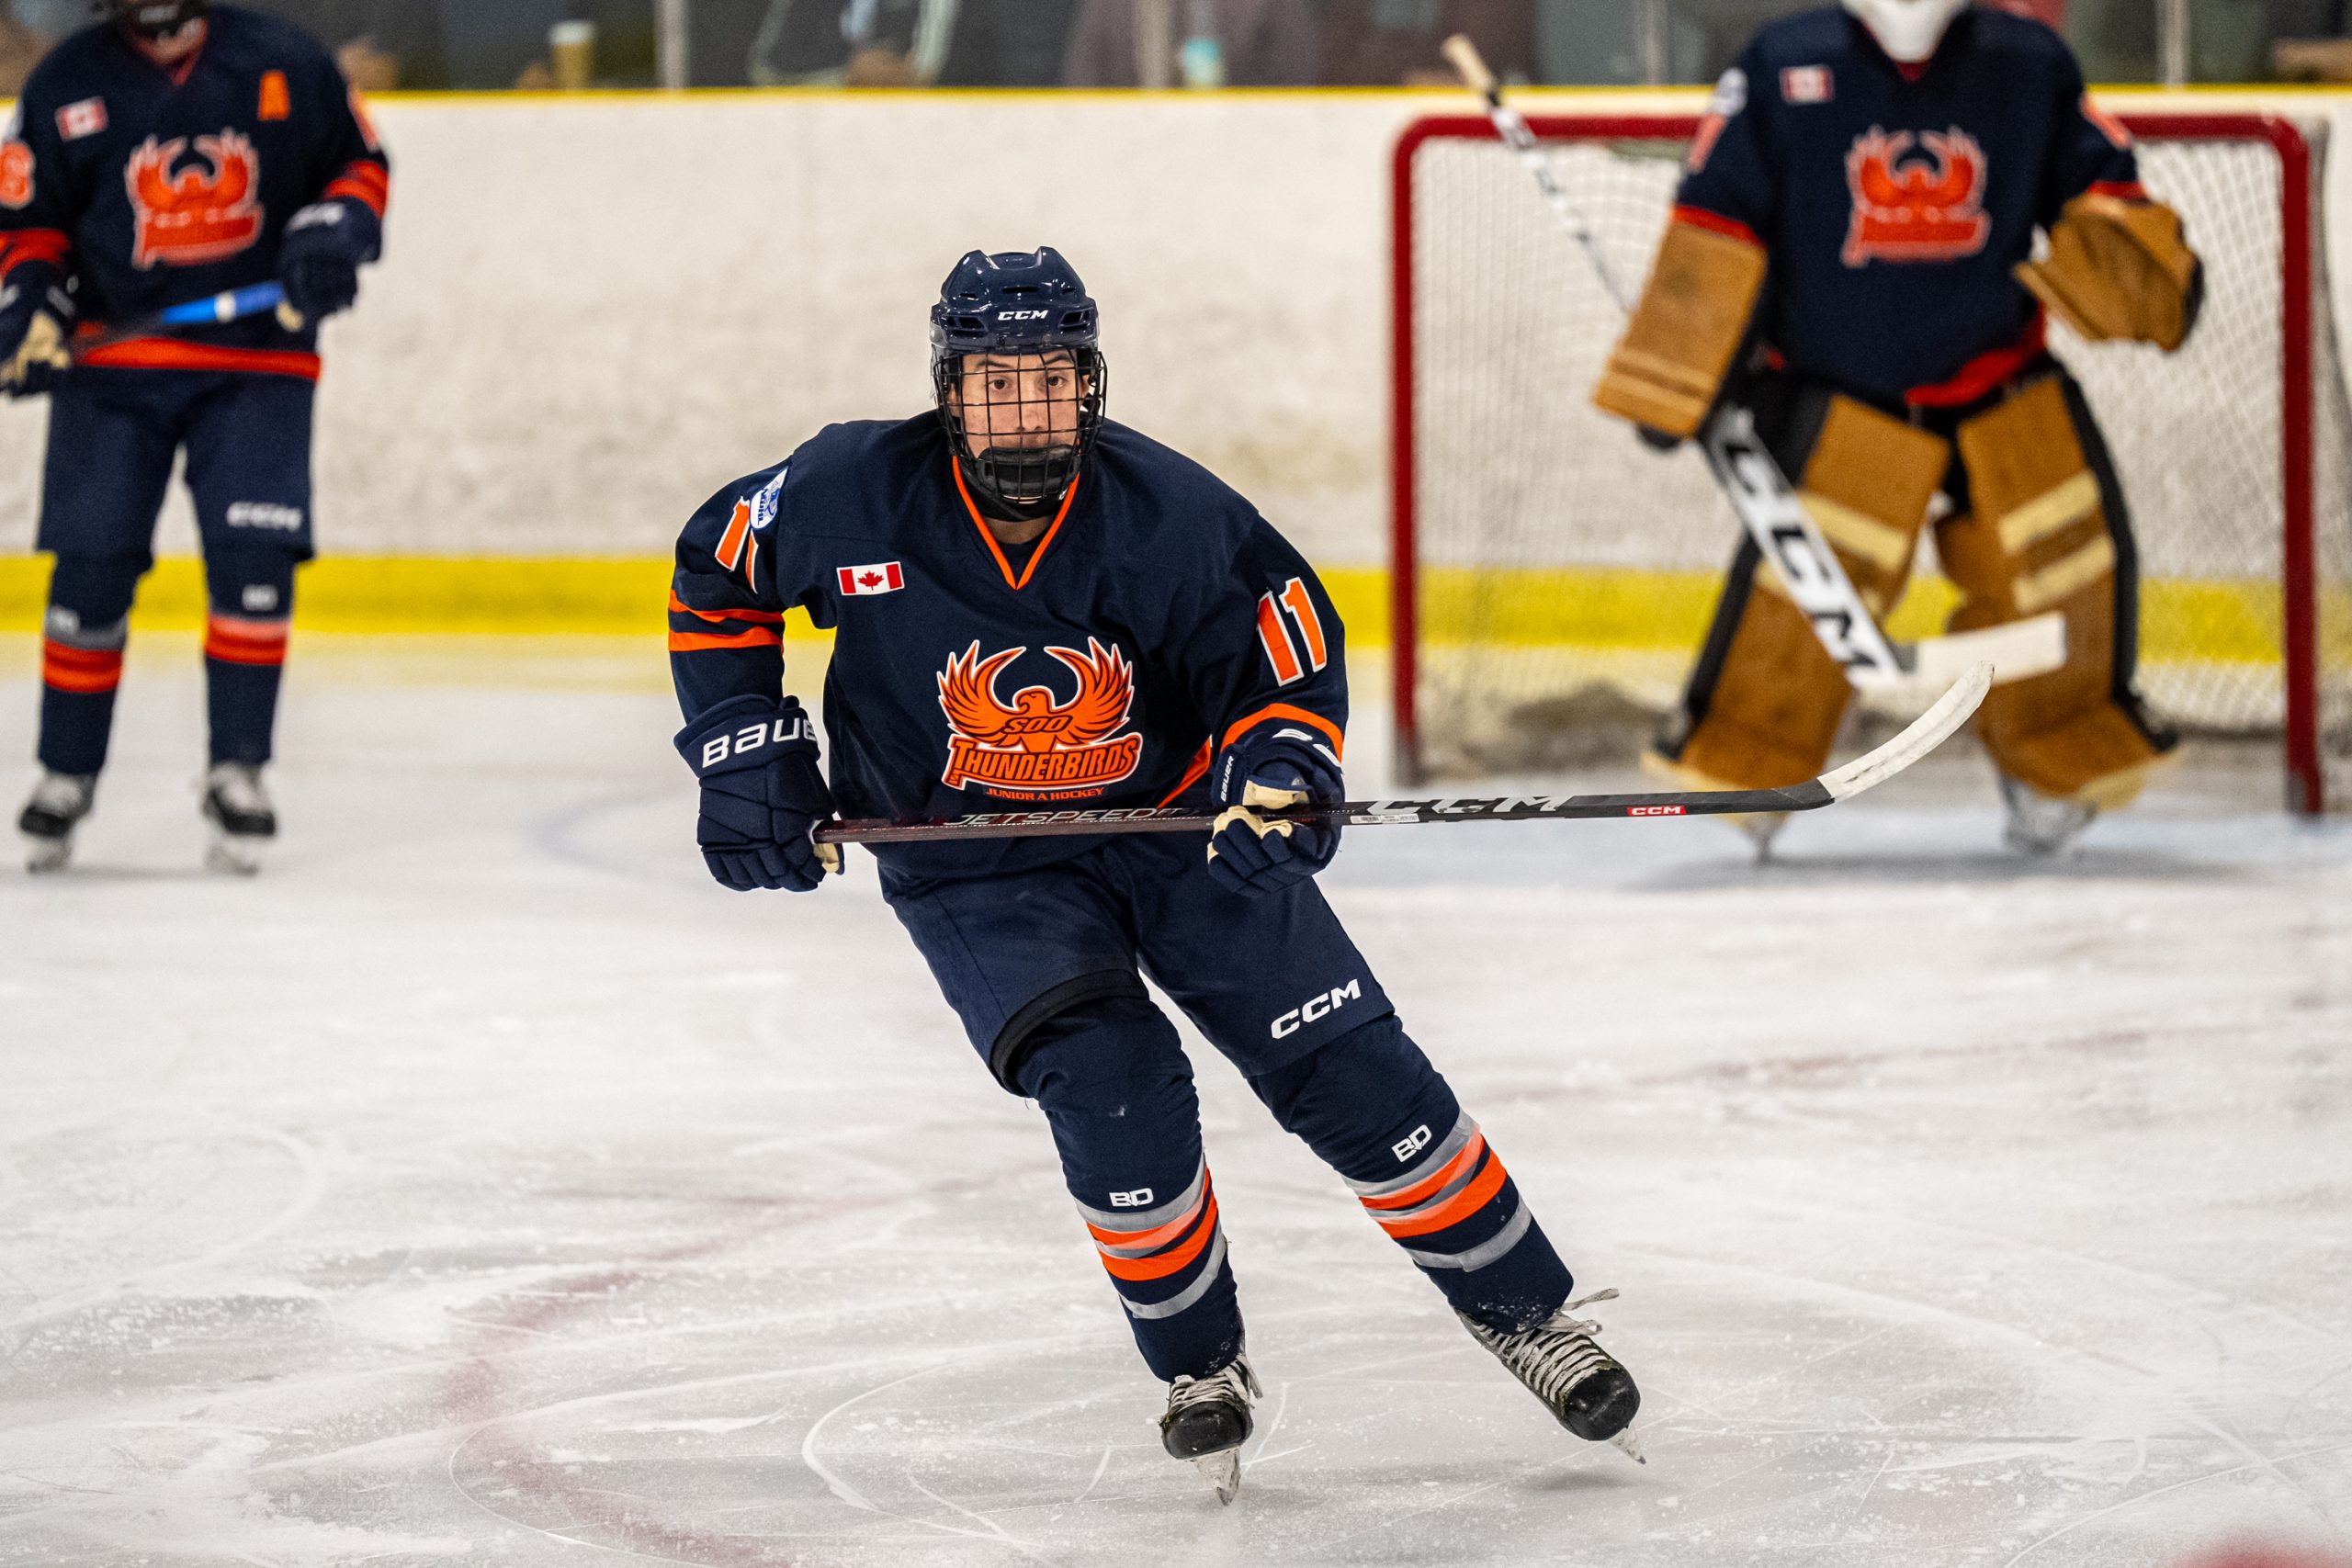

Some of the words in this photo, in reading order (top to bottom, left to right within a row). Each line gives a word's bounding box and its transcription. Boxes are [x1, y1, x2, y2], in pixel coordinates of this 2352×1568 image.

[998, 310, 1049, 321] CCM
[1256, 577, 1328, 687] 11
[1002, 716, 1073, 734] SOO
[952, 737, 1139, 782] THUNDERBIRDS
[985, 787, 1035, 801] JUNIOR
[1037, 793, 1048, 801] A
[1050, 786, 1104, 801] HOCKEY
[1366, 795, 1572, 814] CCM
[1631, 807, 1684, 816] CCM
[944, 807, 1158, 826] JETSPEED
[1271, 978, 1362, 1040] CCM
[1391, 1124, 1432, 1163] BD
[1109, 1188, 1154, 1207] BD
